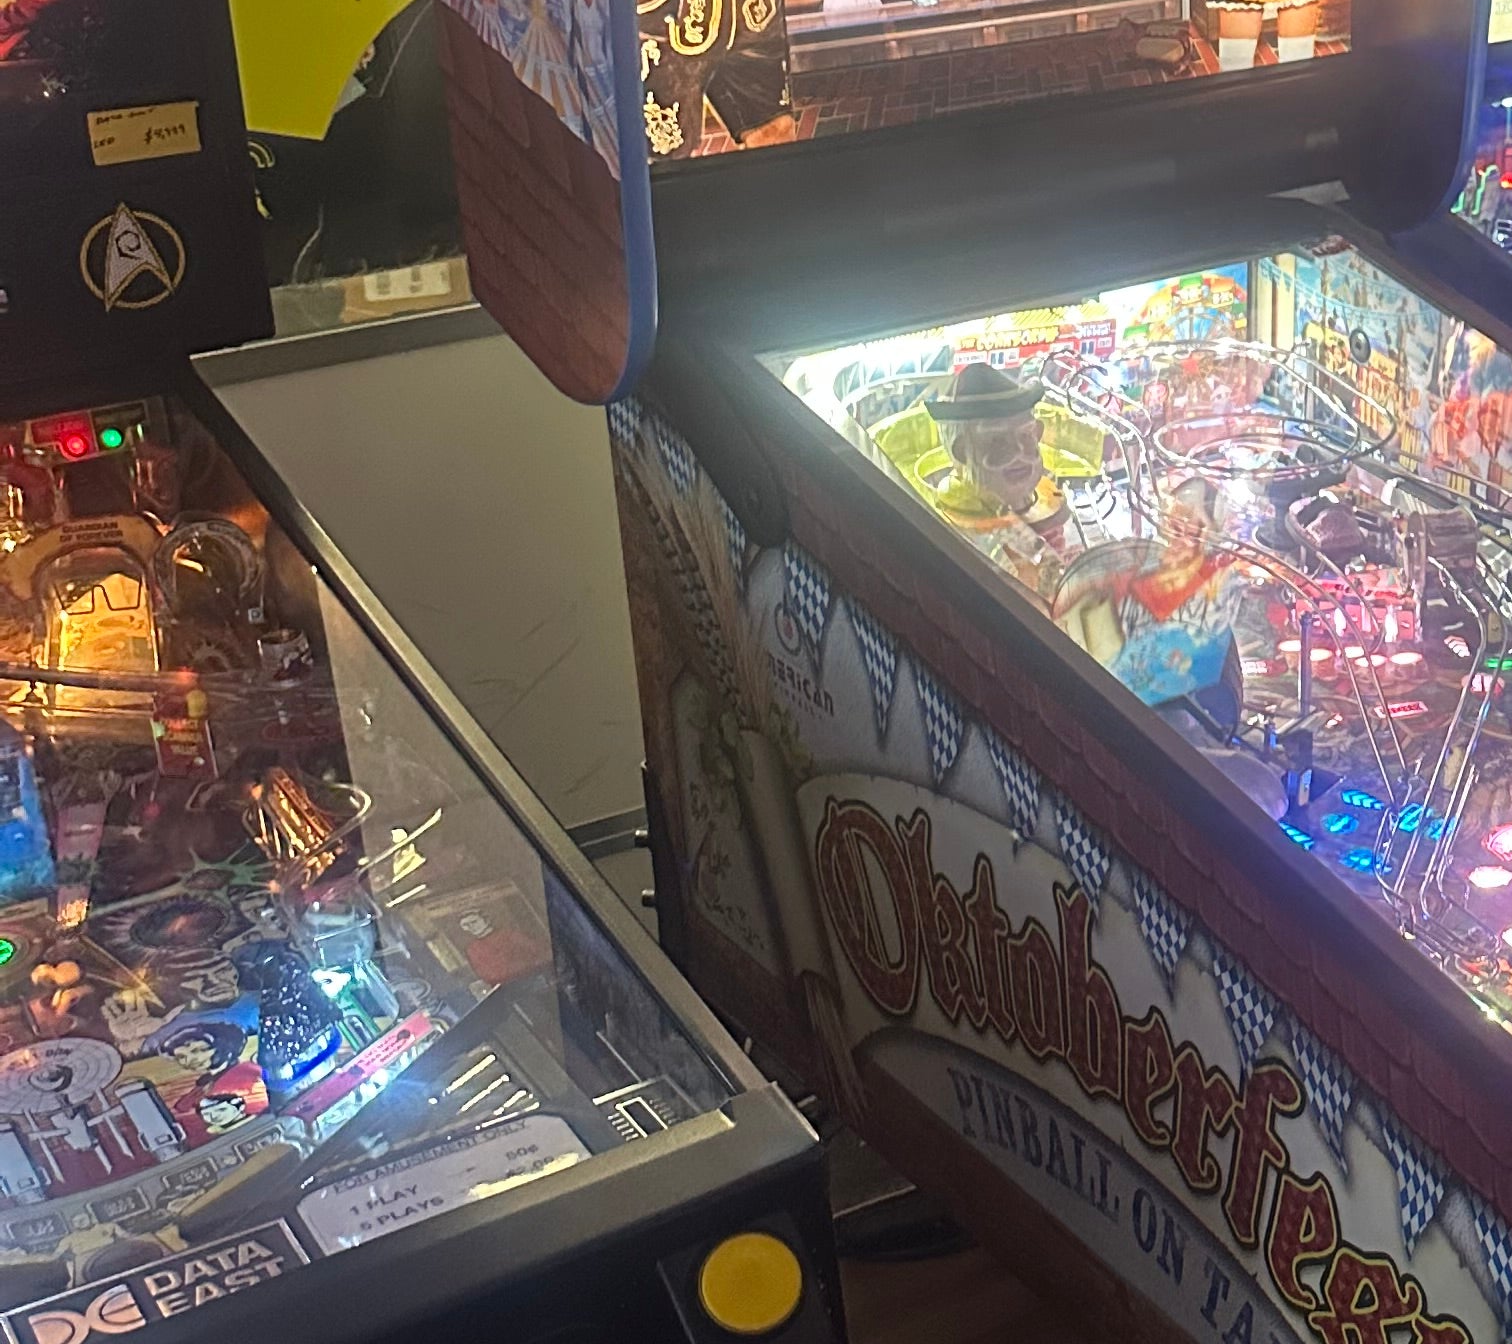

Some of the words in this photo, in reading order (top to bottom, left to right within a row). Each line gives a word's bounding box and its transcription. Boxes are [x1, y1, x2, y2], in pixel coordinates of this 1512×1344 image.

[61, 521, 118, 533] GUARDIAN
[363, 1136, 479, 1183] AMUSEMENT
[480, 1119, 529, 1143] ONLY
[948, 1067, 1122, 1216] PINBALL
[1131, 1187, 1191, 1285] ON
[366, 1183, 420, 1211] PLAY
[376, 1194, 445, 1226] PLAYS
[143, 1239, 274, 1297] DATA
[154, 1256, 286, 1319] EAST
